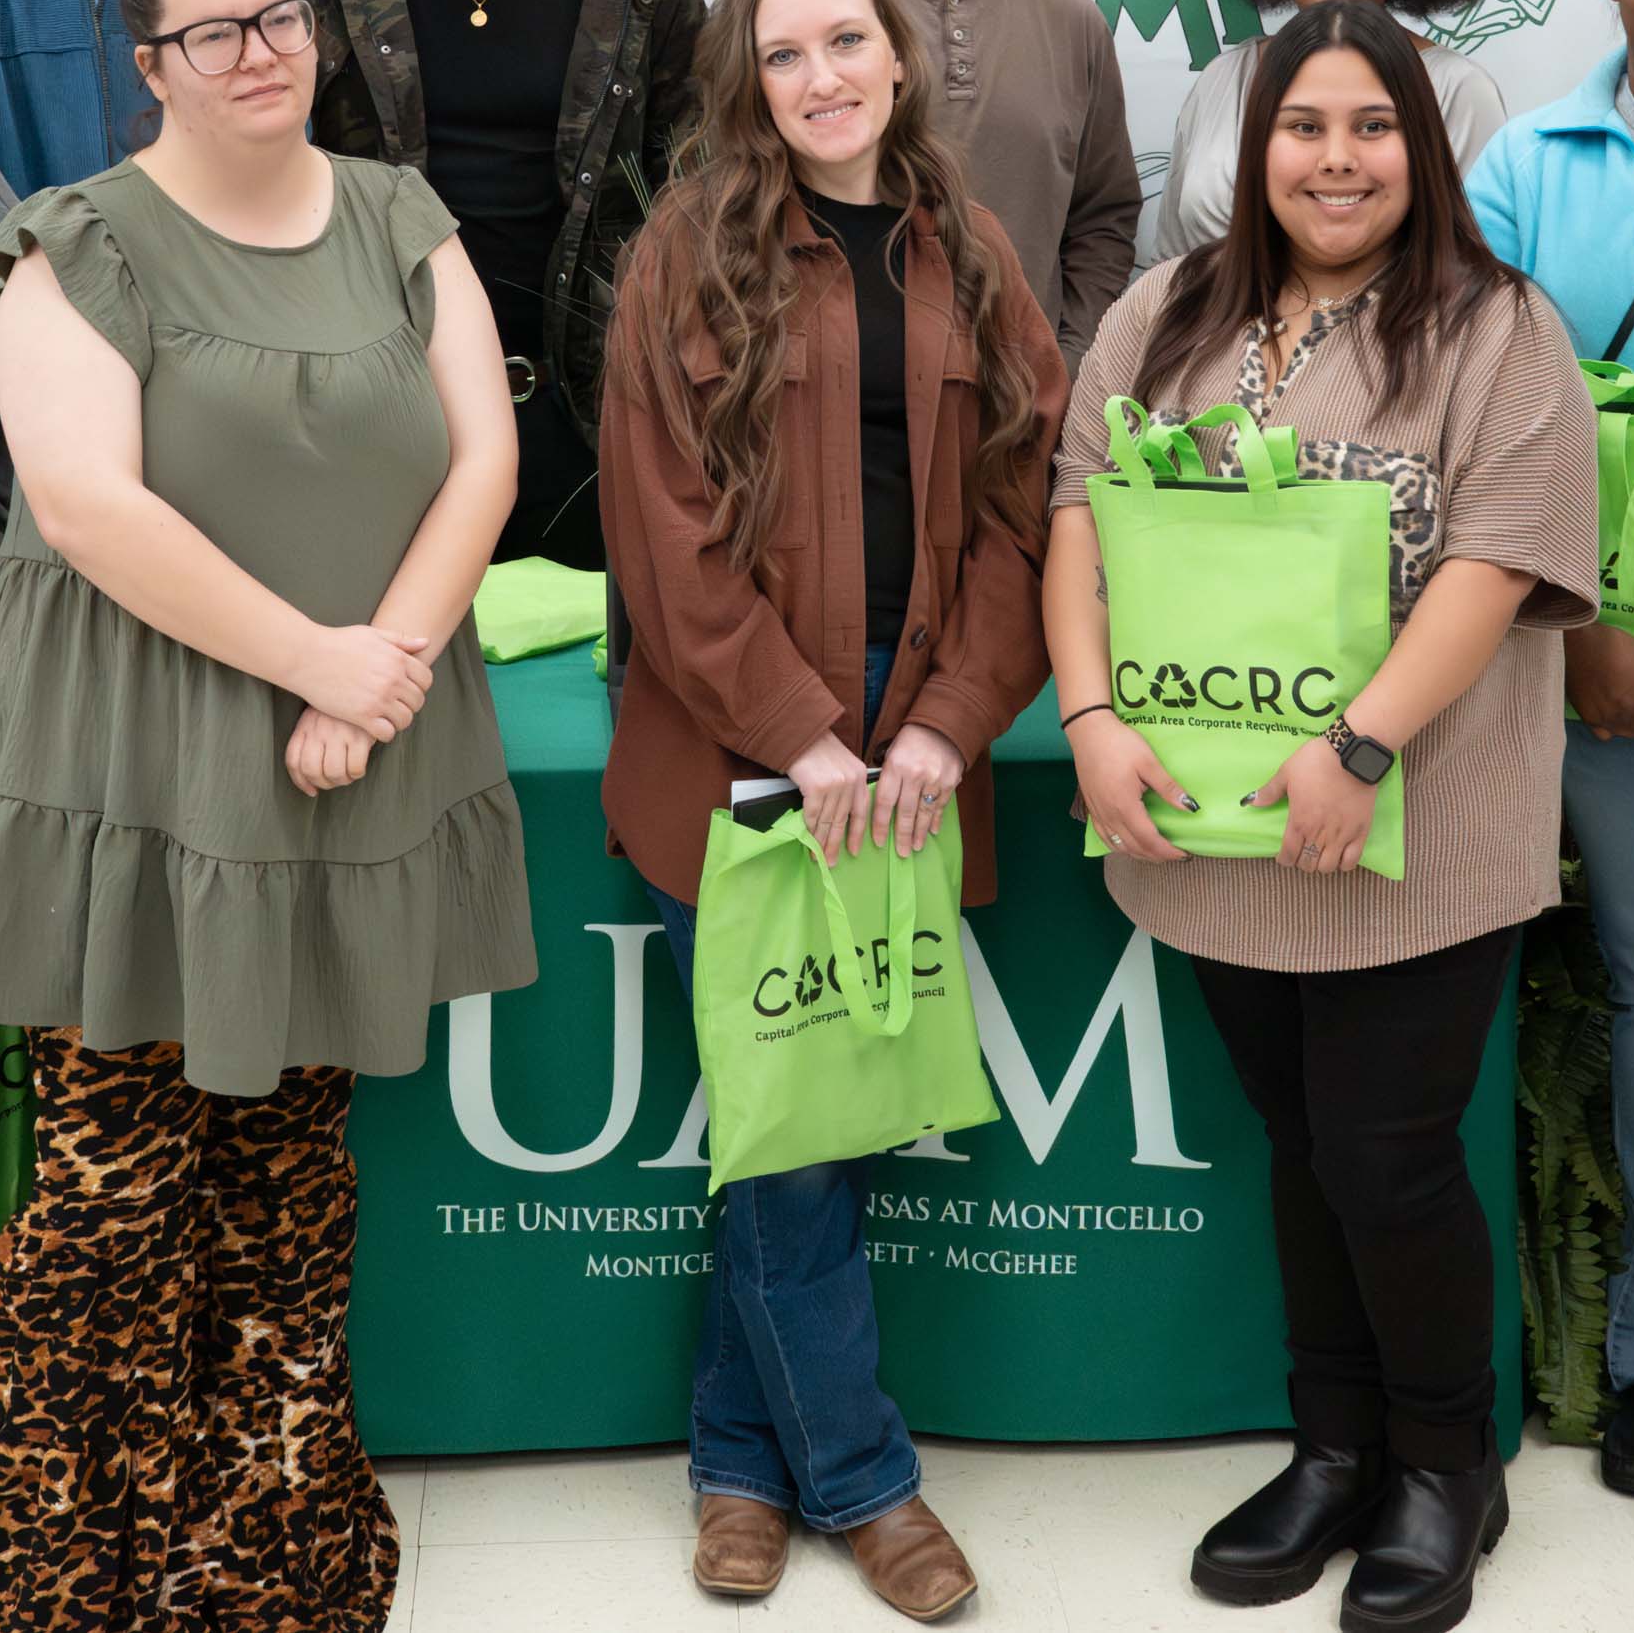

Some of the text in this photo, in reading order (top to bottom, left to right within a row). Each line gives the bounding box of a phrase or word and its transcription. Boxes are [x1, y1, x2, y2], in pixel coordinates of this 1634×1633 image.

[1600, 600, 1617, 611] rea
[1160, 715, 1185, 727] Area
[1188, 716, 1242, 730] Corporate
[1246, 718, 1299, 736] Recycling
[754, 1023, 795, 1043] Capital
[810, 1007, 851, 1026] Corpora
[912, 986, 946, 1000] ouncil
[447, 922, 1211, 1171] UM
[436, 1204, 506, 1234] THE
[517, 1202, 711, 1232] UNIVERSITY
[939, 1199, 979, 1225] AT
[988, 1199, 1205, 1233] MONTICELLO
[584, 1252, 714, 1278] MONTICE
